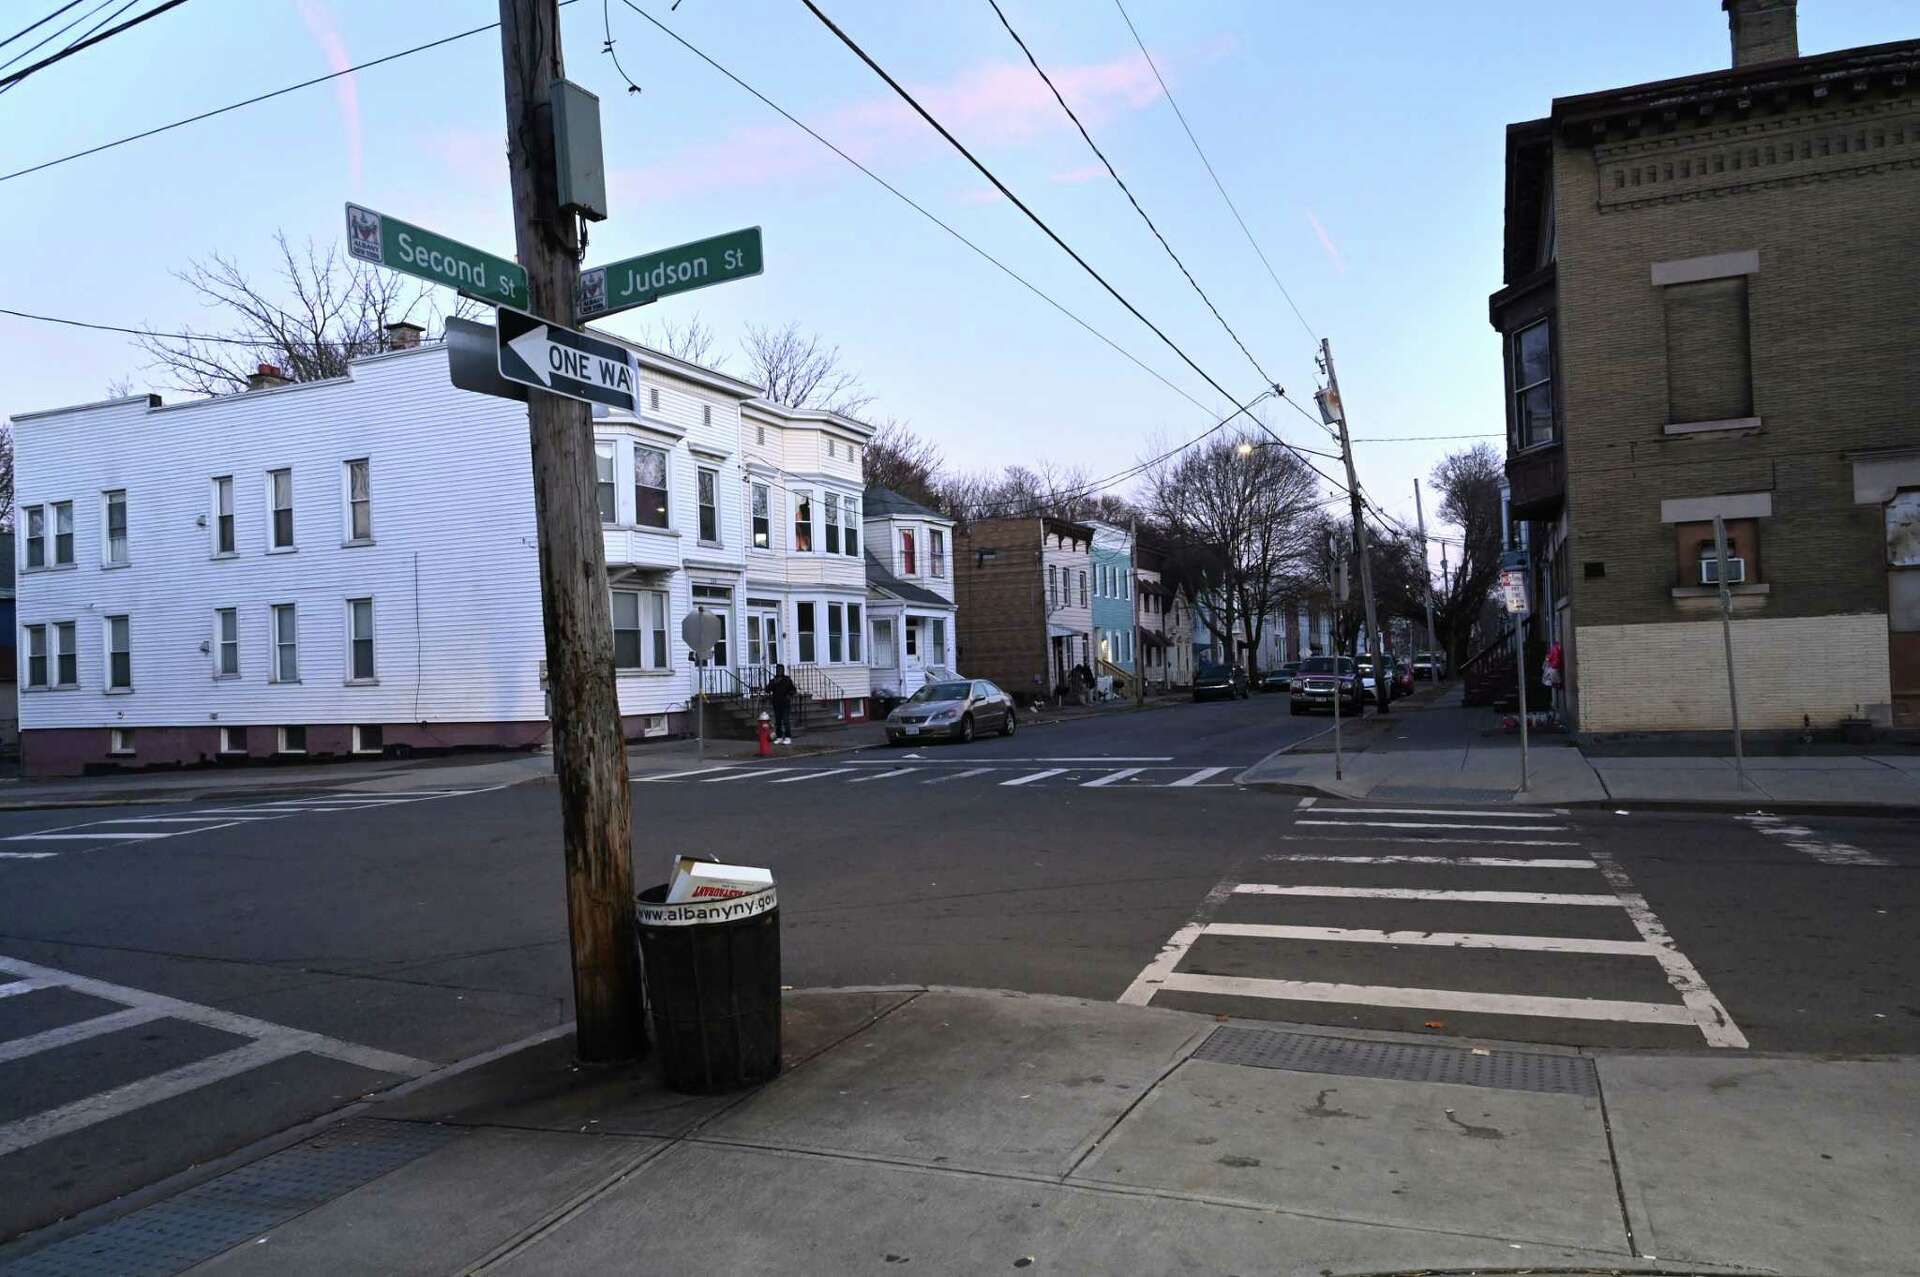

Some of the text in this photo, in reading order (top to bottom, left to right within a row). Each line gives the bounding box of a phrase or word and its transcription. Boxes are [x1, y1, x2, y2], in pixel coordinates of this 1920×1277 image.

[398, 233, 515, 299] Second St
[620, 248, 744, 296] Judson St
[549, 345, 592, 381] ONE
